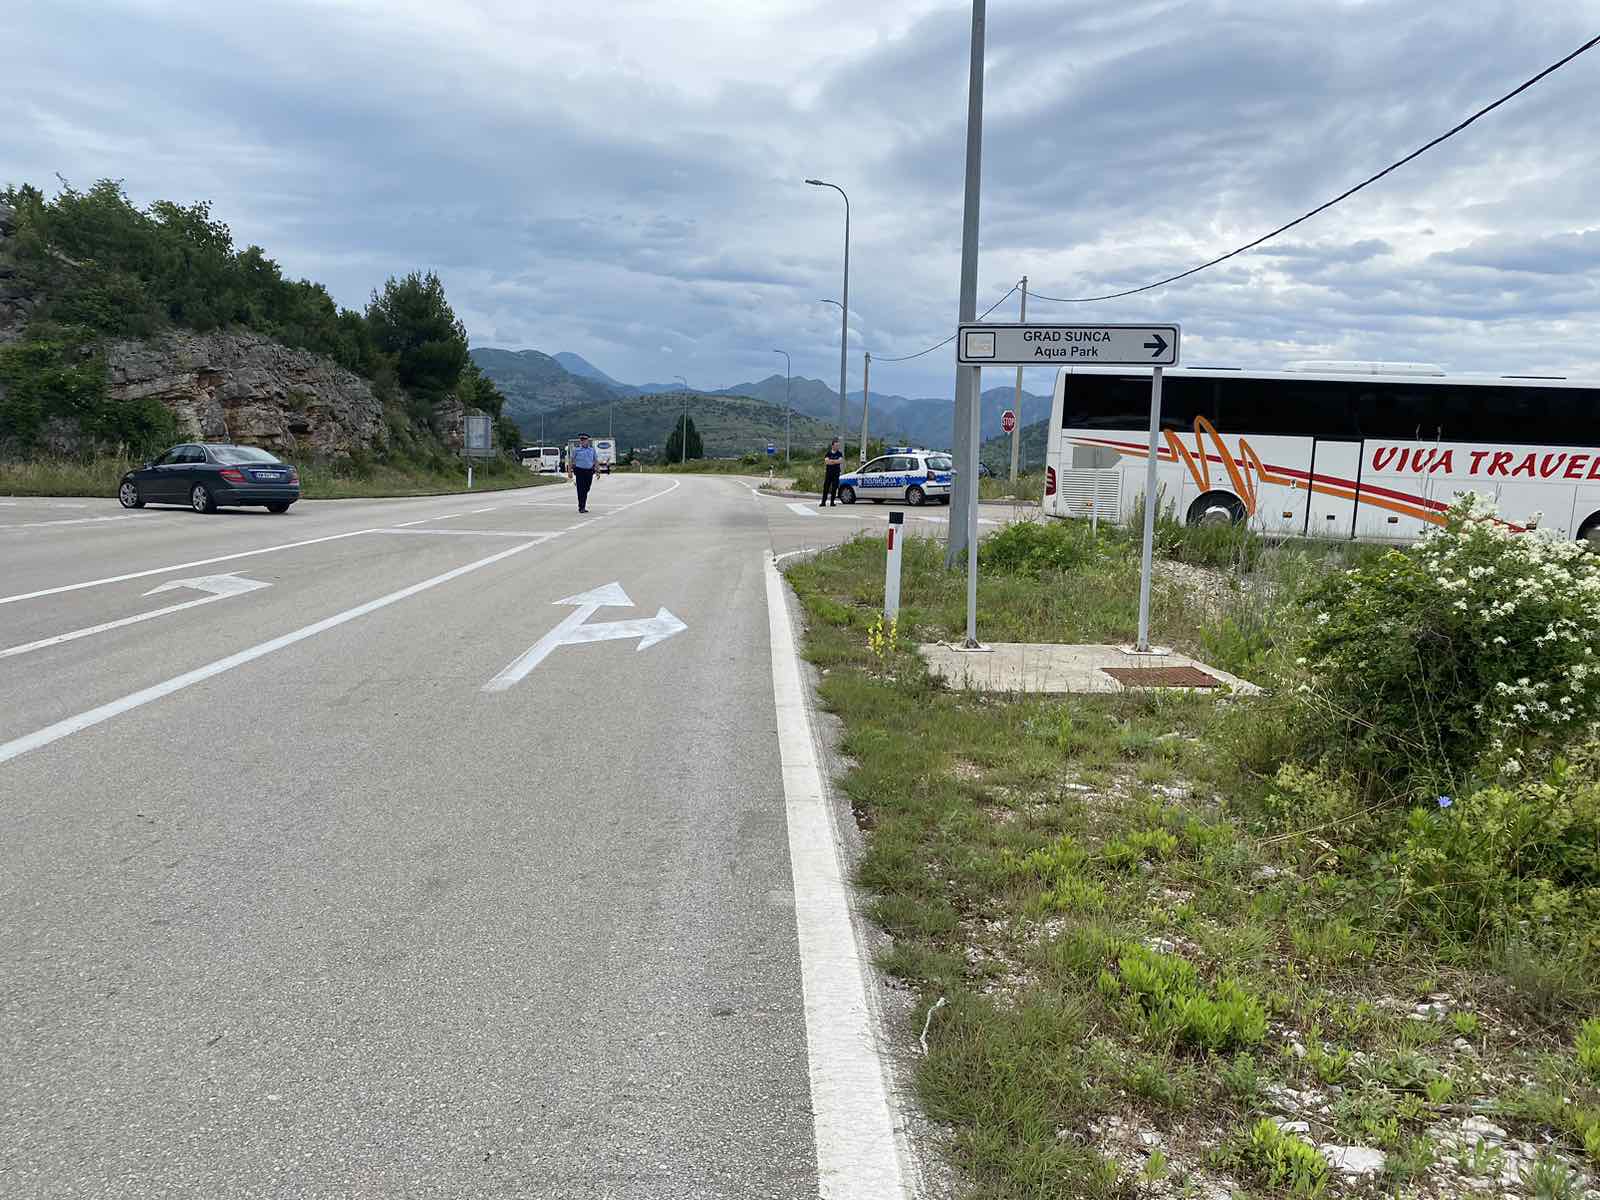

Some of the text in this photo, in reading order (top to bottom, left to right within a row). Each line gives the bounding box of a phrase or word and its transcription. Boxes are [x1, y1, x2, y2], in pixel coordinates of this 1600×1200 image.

[1023, 331, 1111, 342] GRAD SUNCA
[1034, 346, 1099, 358] Aqua Park
[1002, 417, 1015, 426] STOP
[1372, 447, 1453, 474] VIVA
